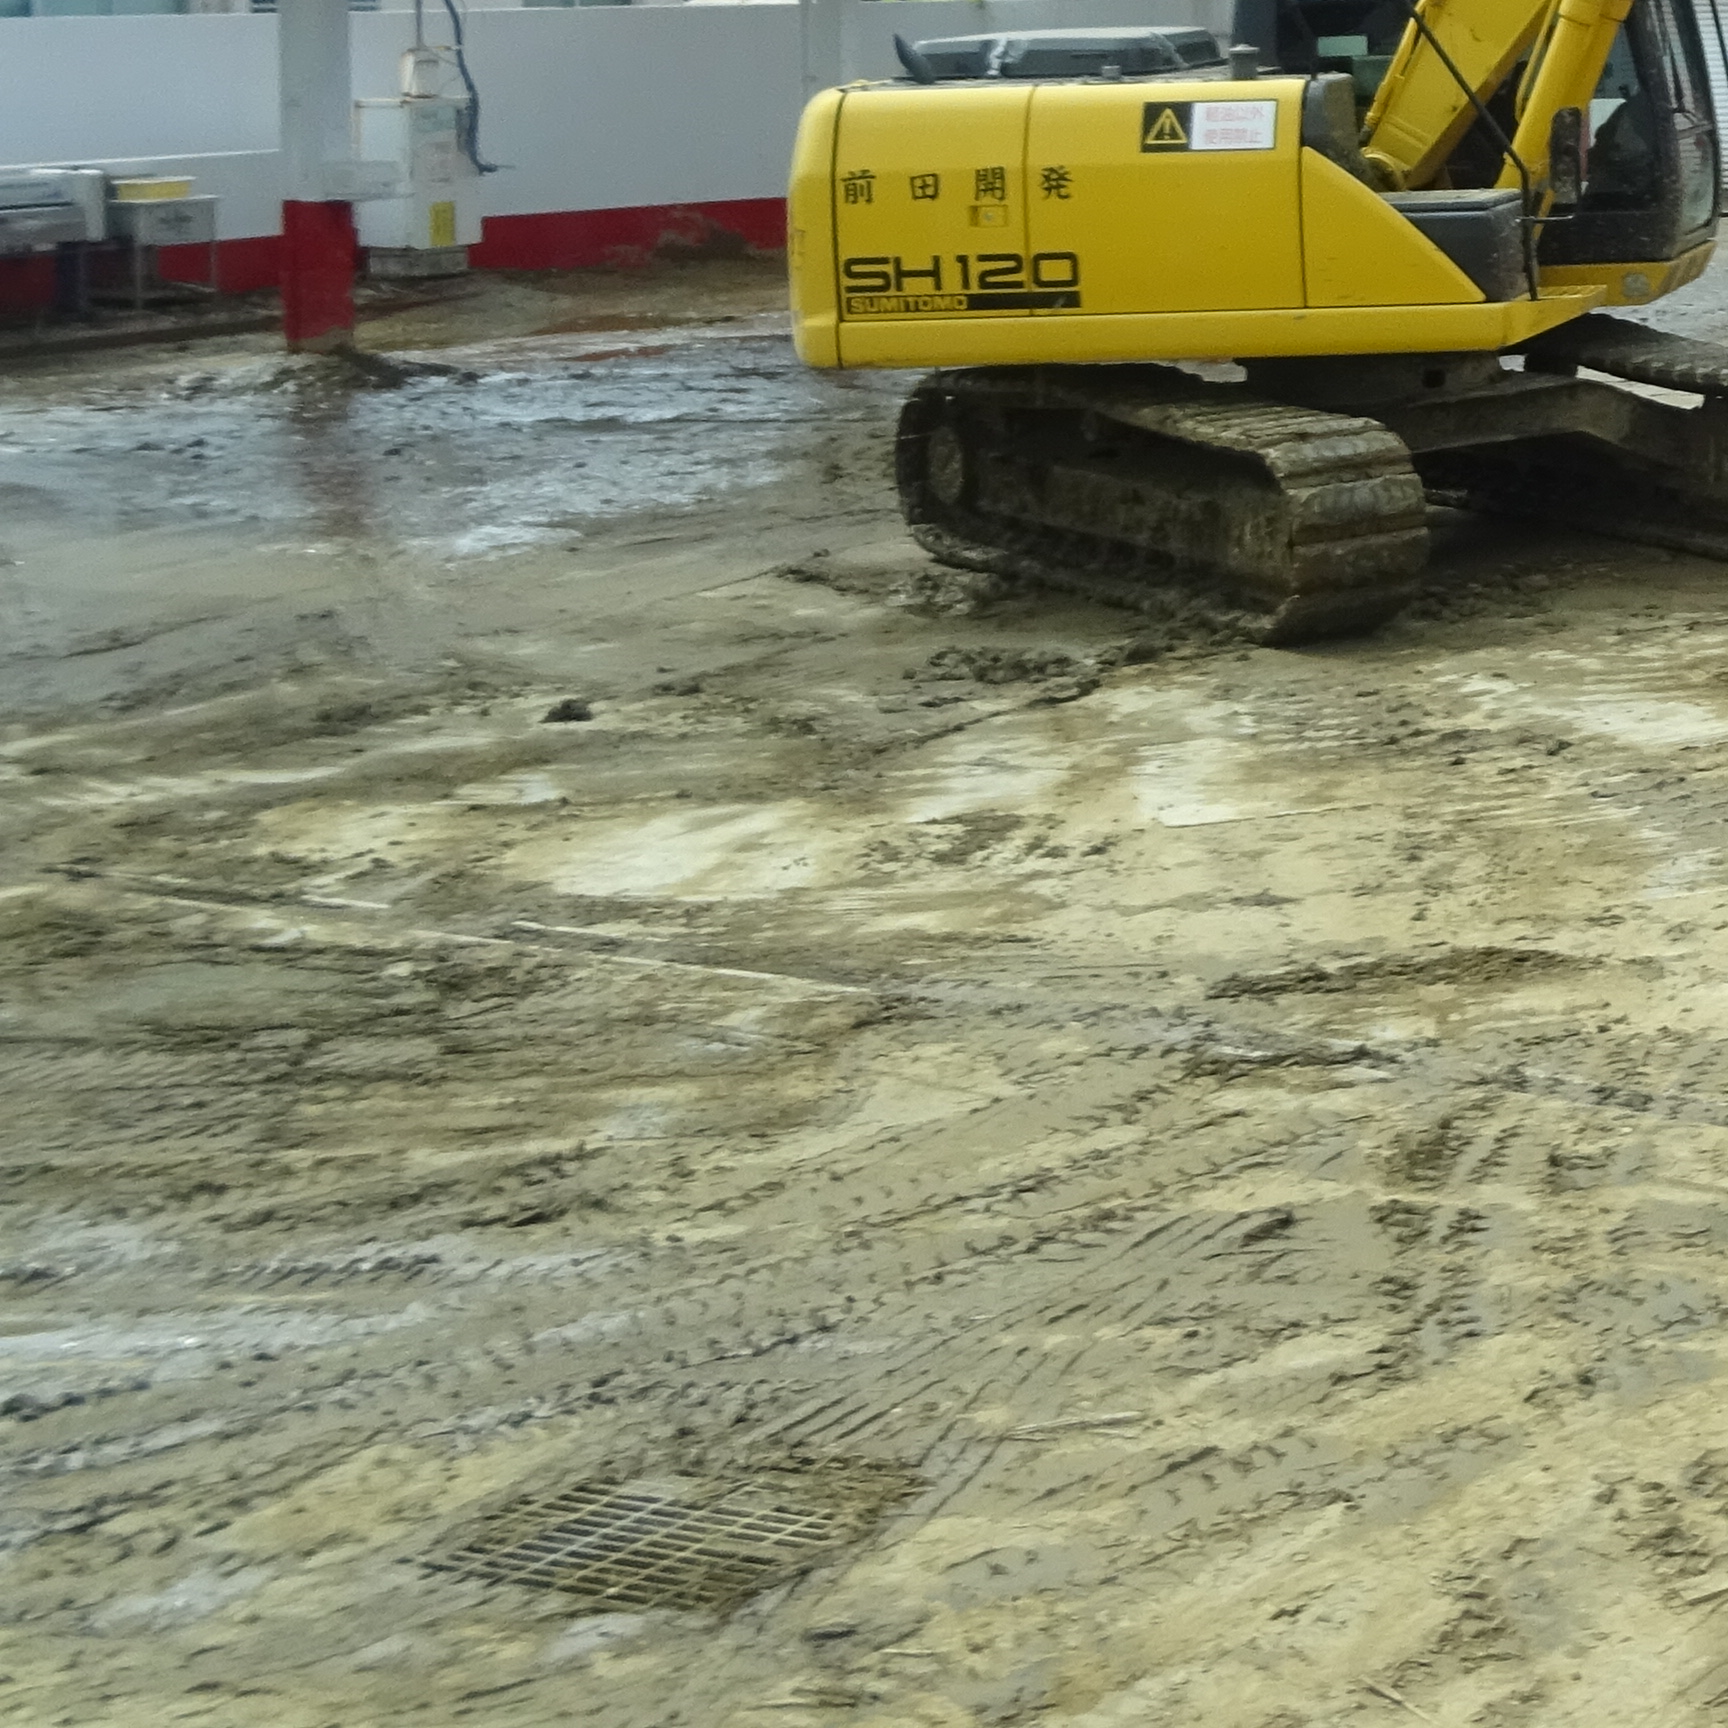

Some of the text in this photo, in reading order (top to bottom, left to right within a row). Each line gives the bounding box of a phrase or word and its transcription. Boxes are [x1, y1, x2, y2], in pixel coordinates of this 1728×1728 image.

[842, 165, 1074, 204] 前田開発
[849, 295, 968, 313] SUMITOMO
